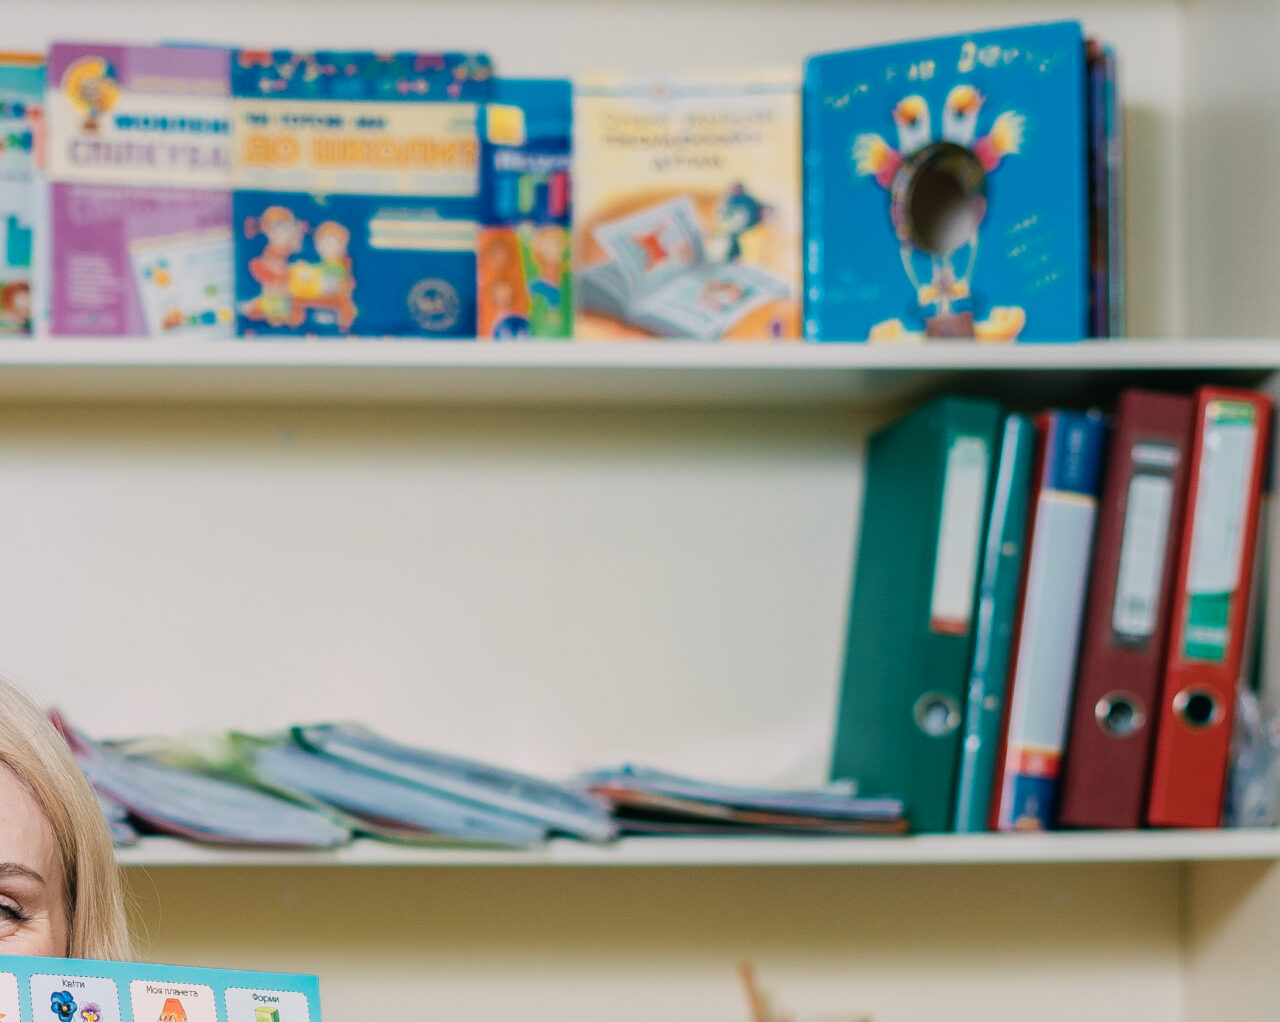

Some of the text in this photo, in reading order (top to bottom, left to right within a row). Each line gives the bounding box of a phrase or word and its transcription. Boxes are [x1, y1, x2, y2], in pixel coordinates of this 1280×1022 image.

[62, 979, 86, 988] Квіти
[146, 986, 199, 998] Моя планета
[251, 993, 279, 1004] Форми
